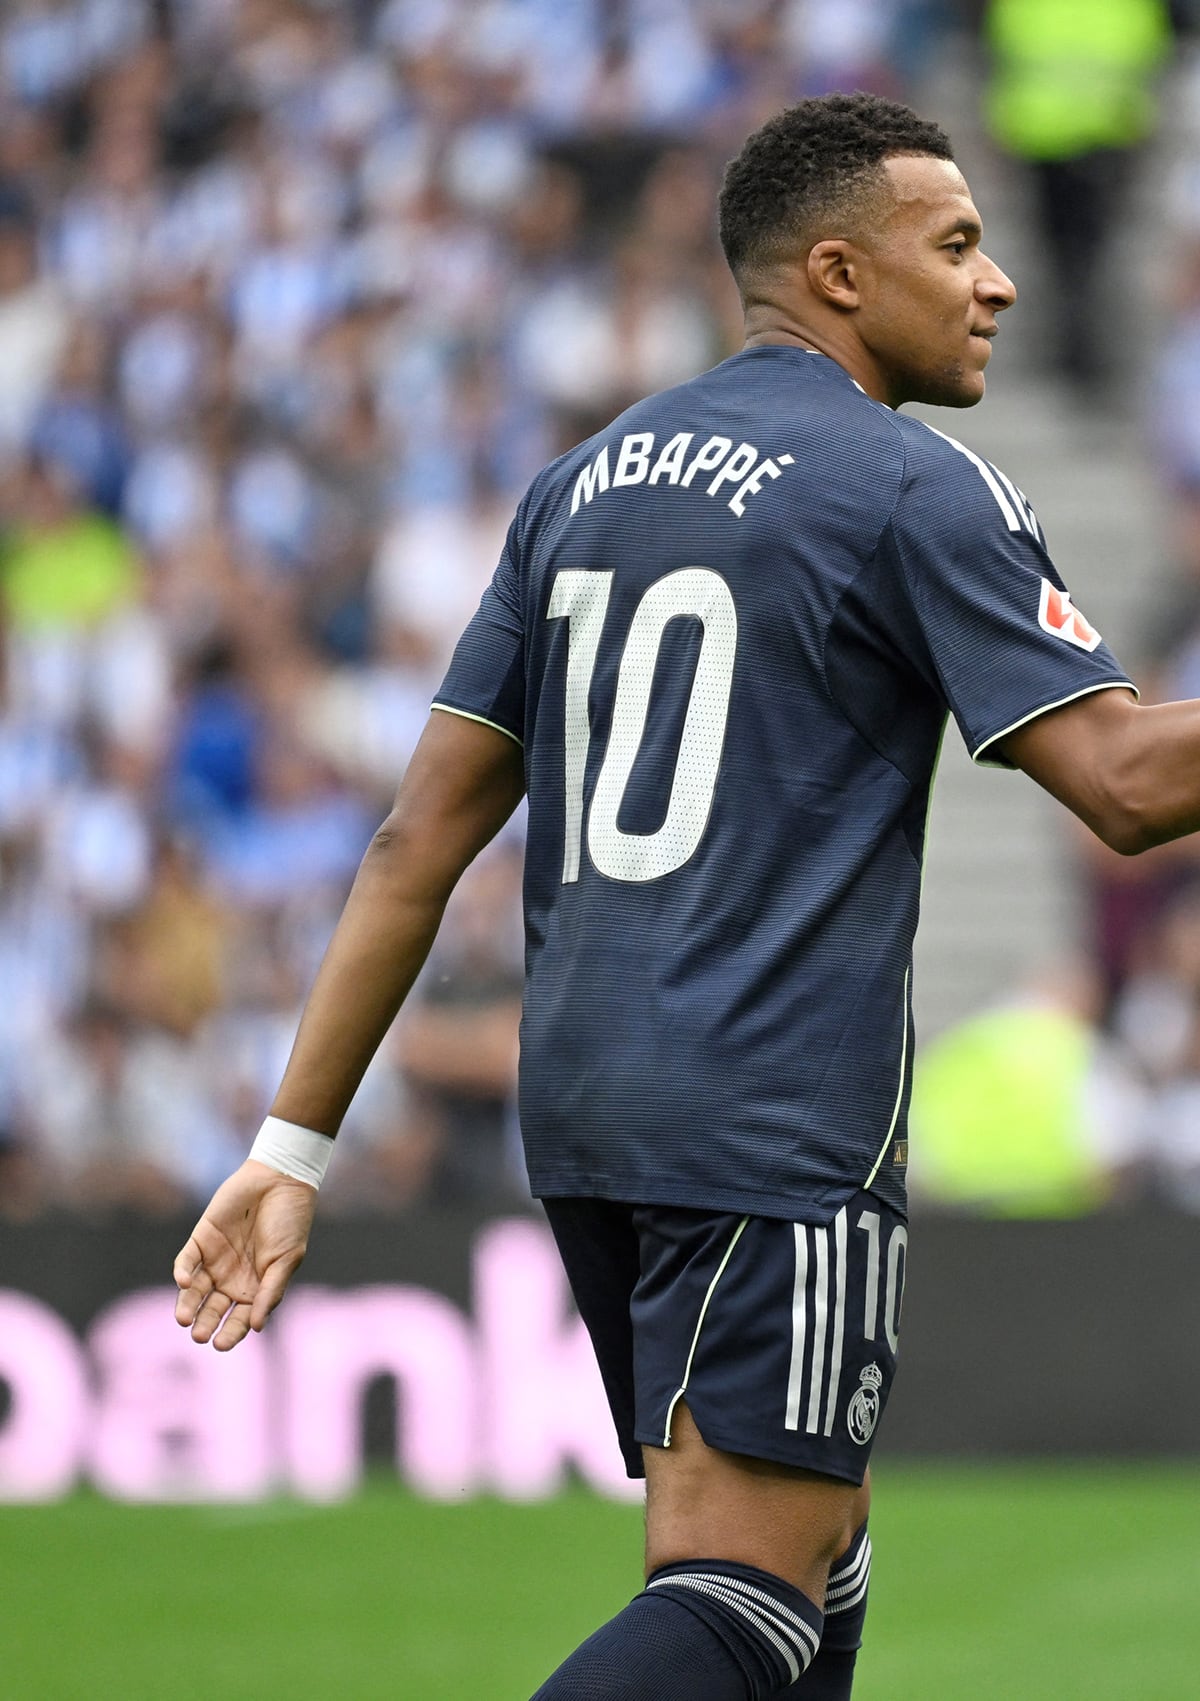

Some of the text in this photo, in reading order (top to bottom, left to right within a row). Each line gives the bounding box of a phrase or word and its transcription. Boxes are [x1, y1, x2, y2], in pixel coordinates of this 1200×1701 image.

[569, 432, 795, 517] MBAPPÉ
[546, 566, 738, 883] 10
[857, 1210, 908, 1354] 10
